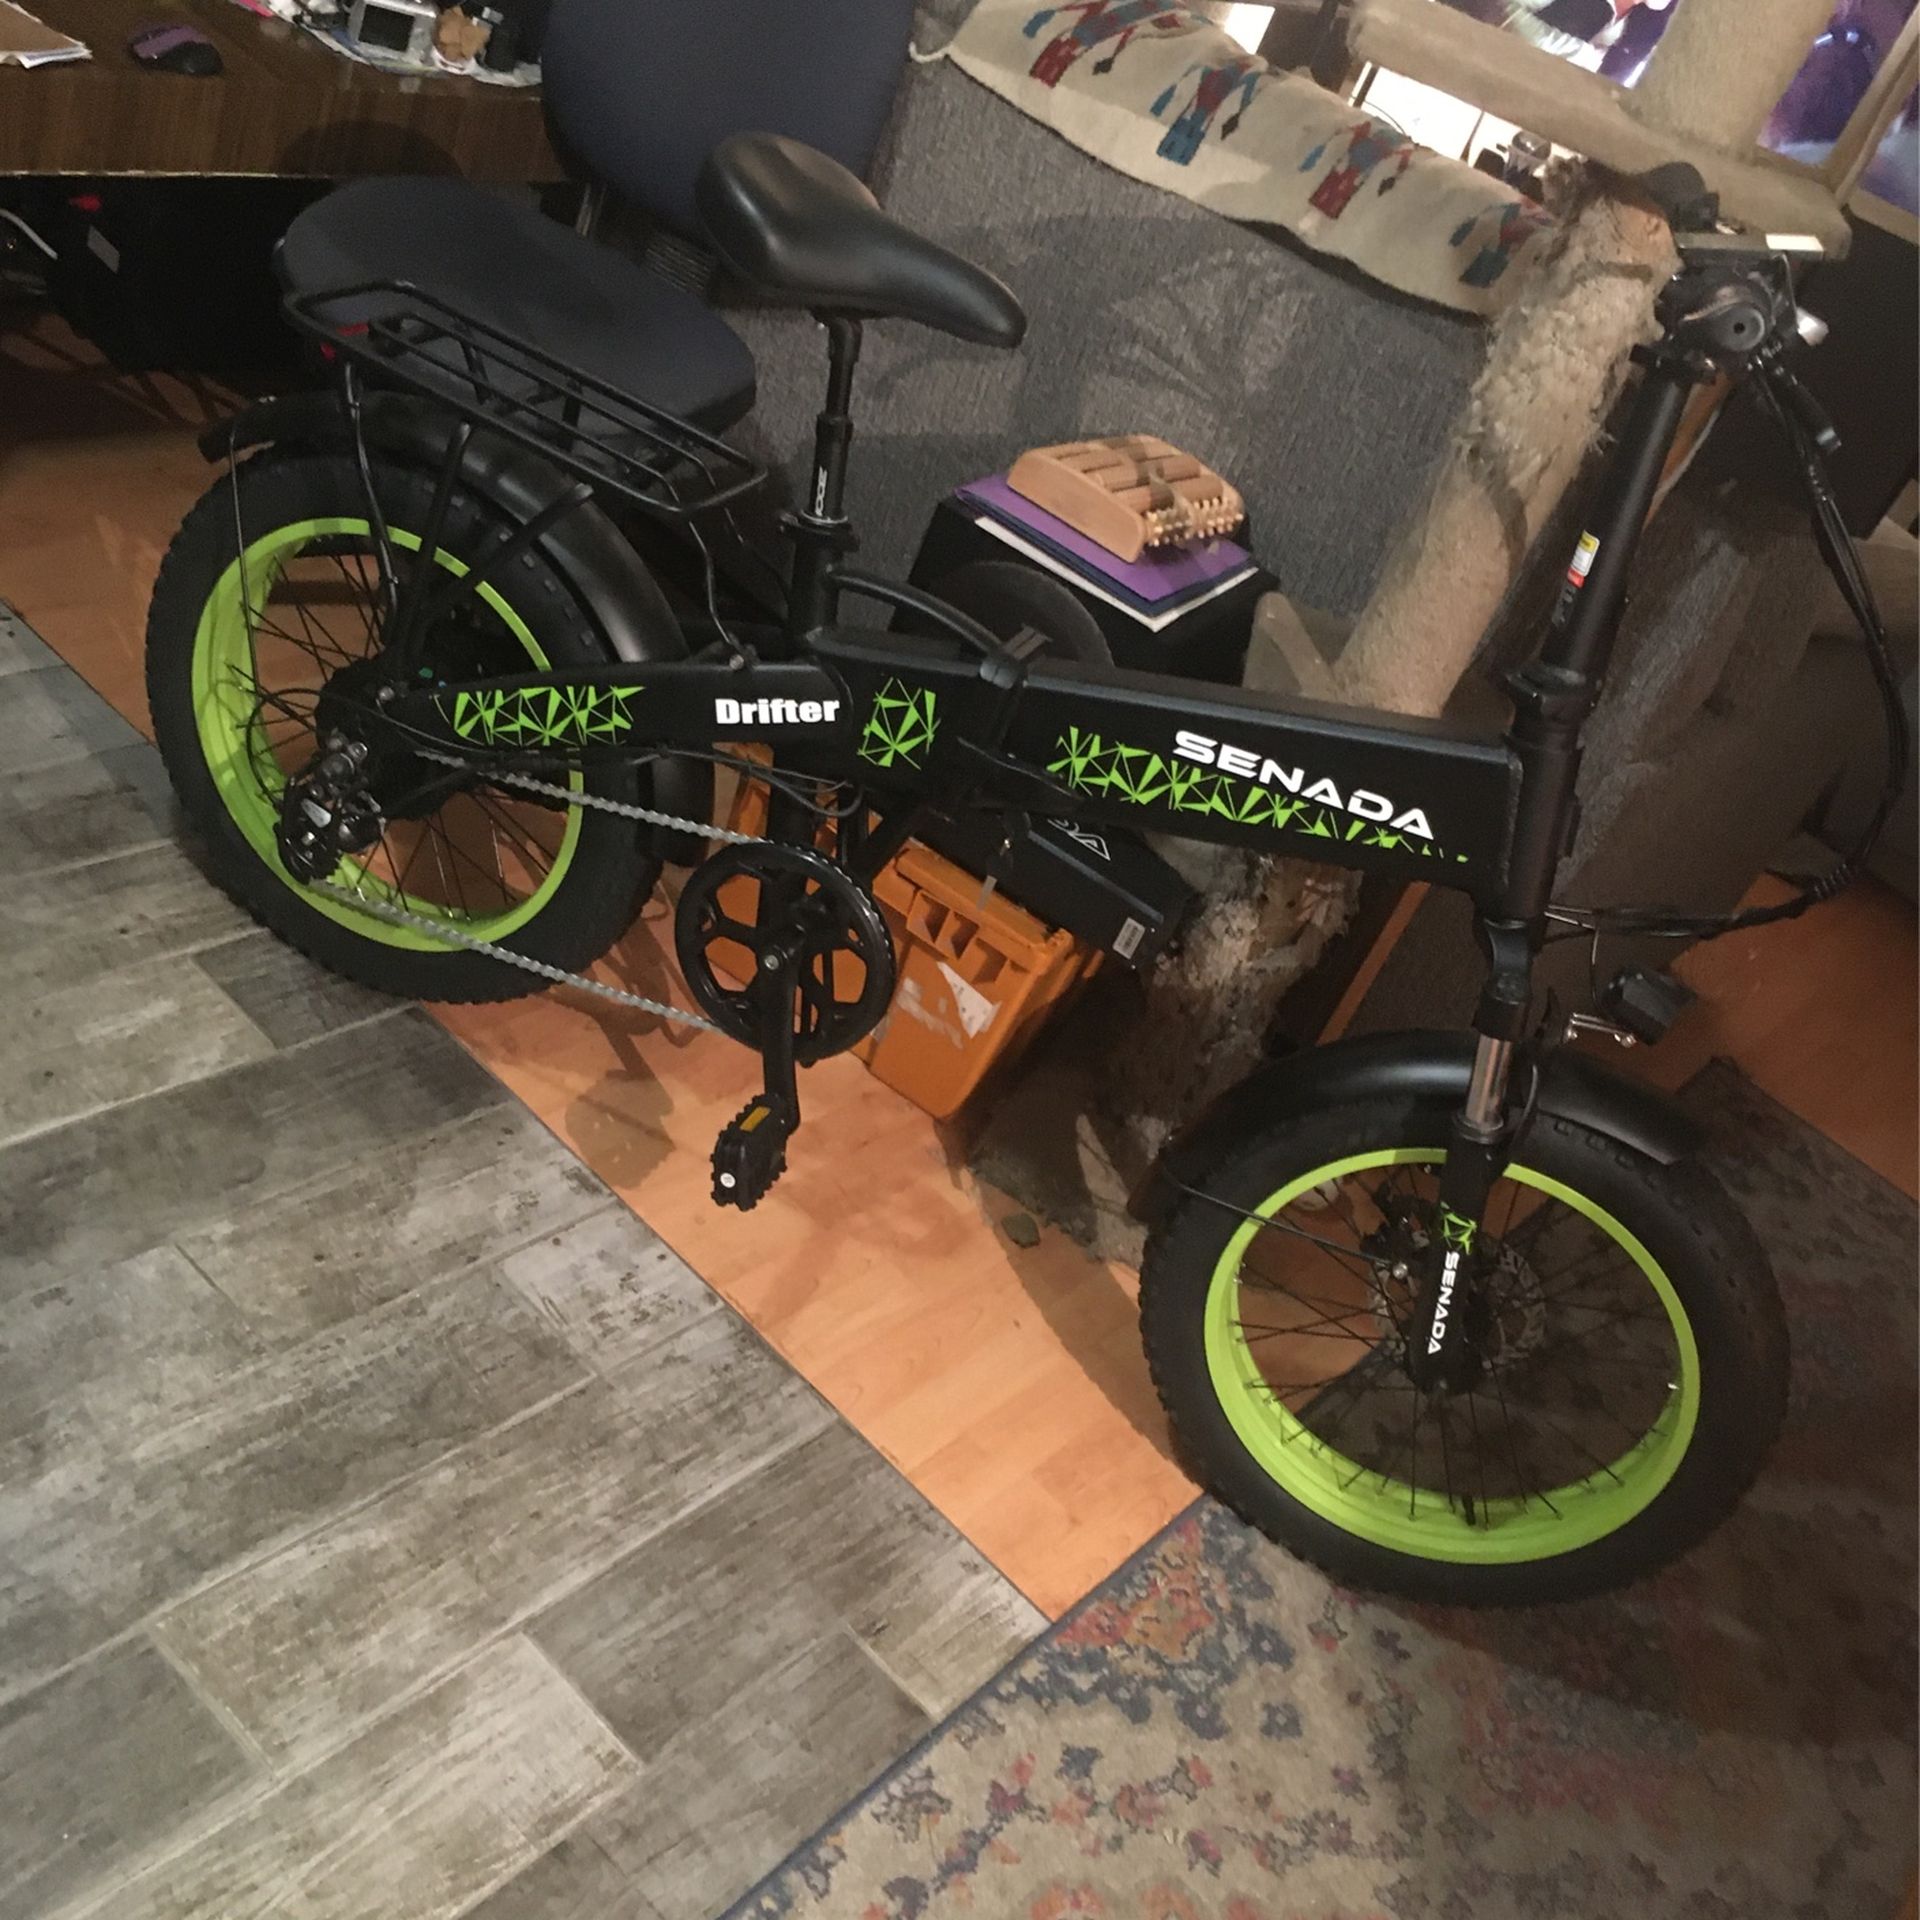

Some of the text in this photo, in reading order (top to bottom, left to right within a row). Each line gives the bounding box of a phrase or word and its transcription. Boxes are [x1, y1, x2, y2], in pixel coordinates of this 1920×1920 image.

[715, 698, 840, 724] Drifter
[1173, 730, 1434, 840] SENADA
[1428, 1251, 1460, 1355] SENADA
